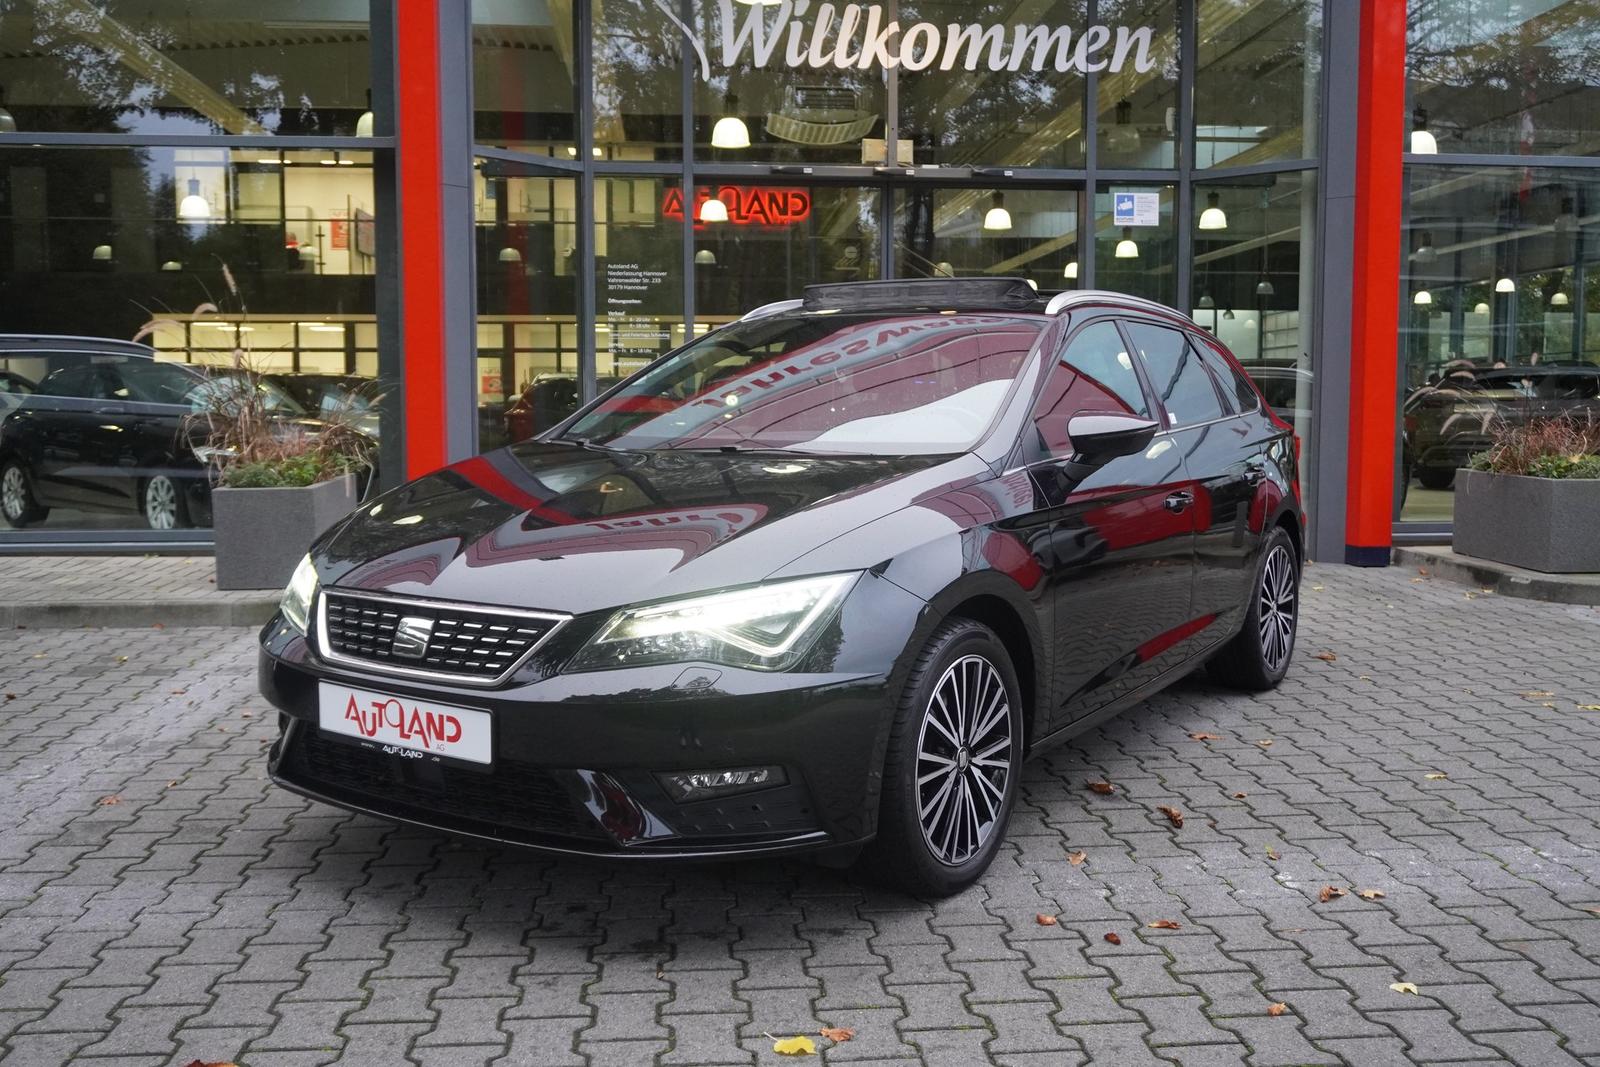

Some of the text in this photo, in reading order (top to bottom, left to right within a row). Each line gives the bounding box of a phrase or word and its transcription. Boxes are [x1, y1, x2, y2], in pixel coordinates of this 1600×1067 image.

[719, 0, 1157, 74] Willkommen
[344, 692, 462, 749] AUTOLAND
[382, 744, 424, 759] AUTOLAND
